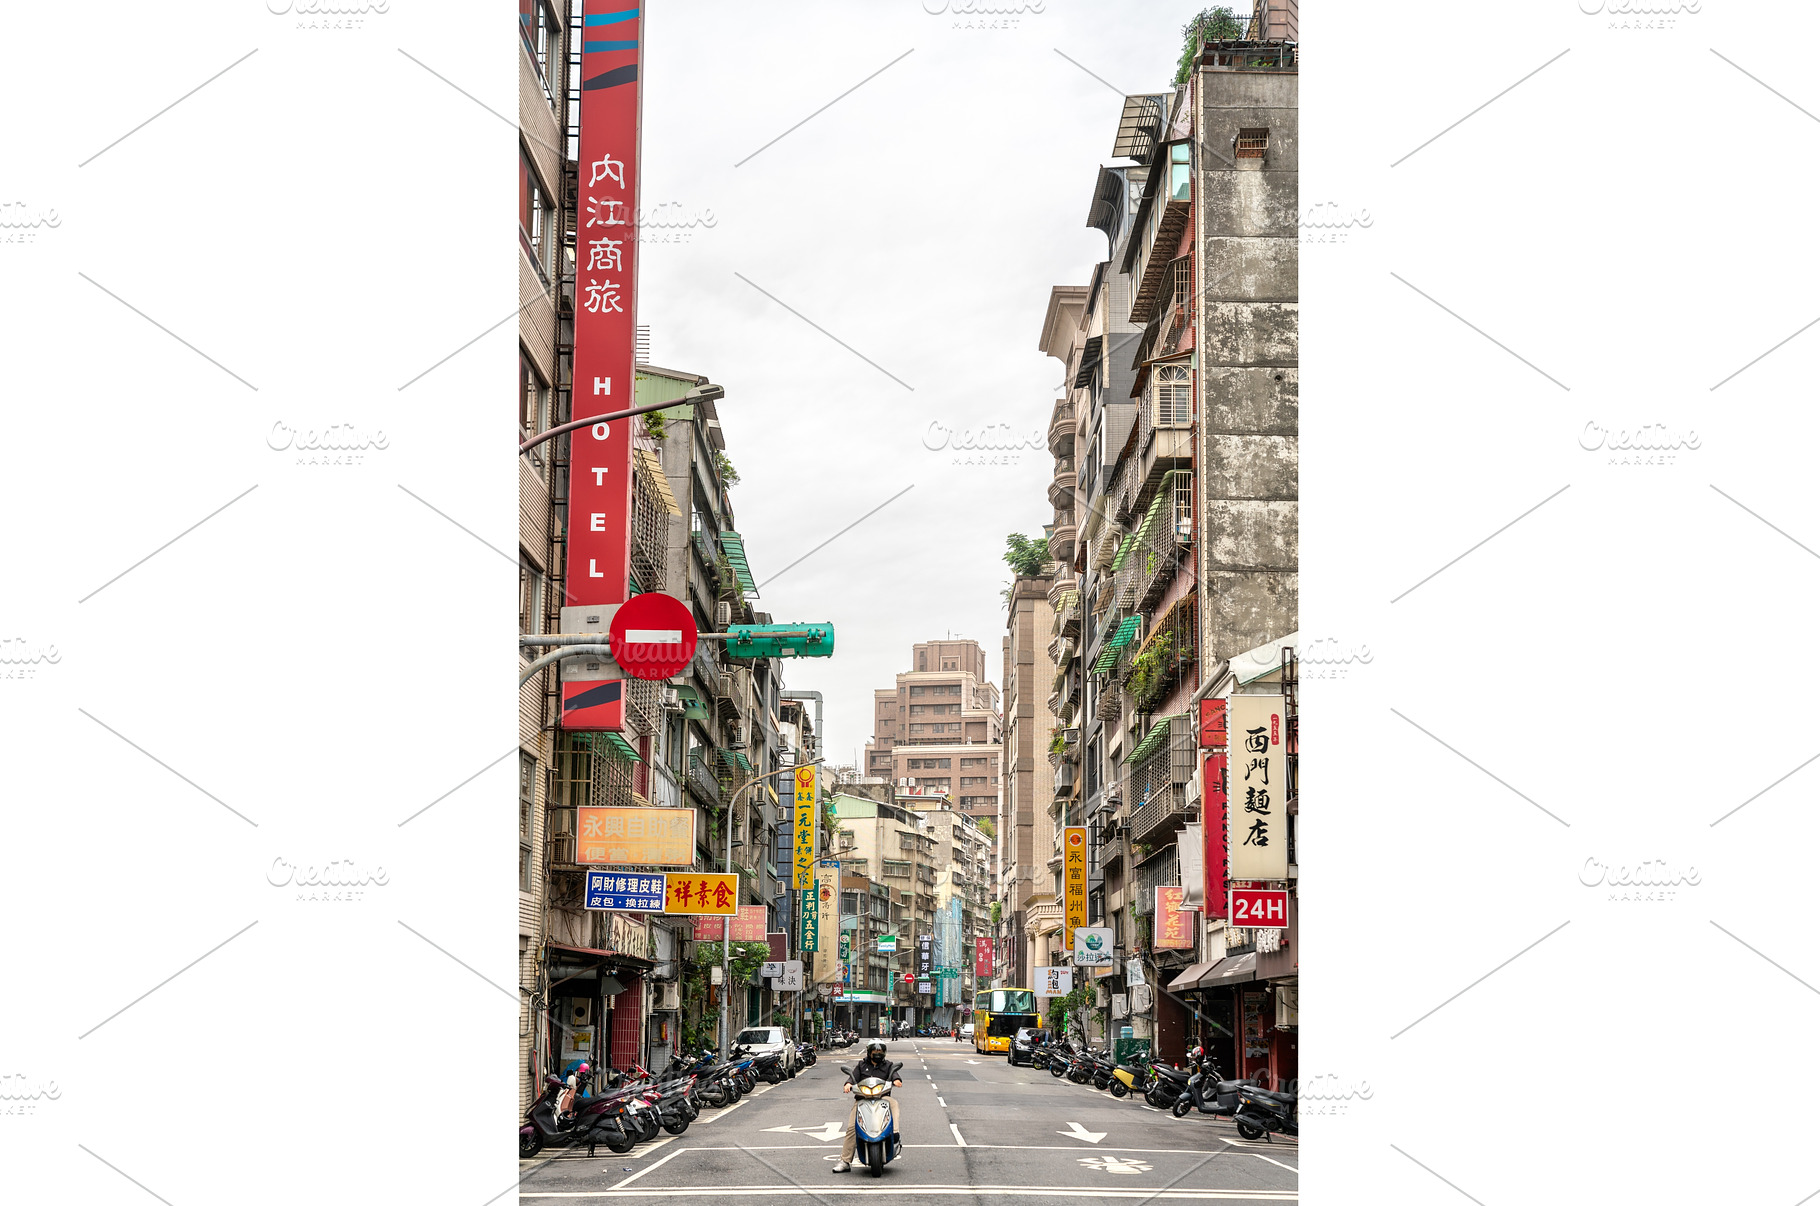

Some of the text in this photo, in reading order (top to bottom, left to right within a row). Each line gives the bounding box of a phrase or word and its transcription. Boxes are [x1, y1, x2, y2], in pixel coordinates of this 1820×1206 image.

[588, 376, 612, 578] HOTEL
[1243, 726, 1271, 847] 西門麵店
[583, 815, 689, 839] 永興自助餐
[591, 876, 662, 894] 阿財修理皮鞋
[1069, 851, 1083, 945] 永富福州魚
[1235, 898, 1283, 920] 24H
